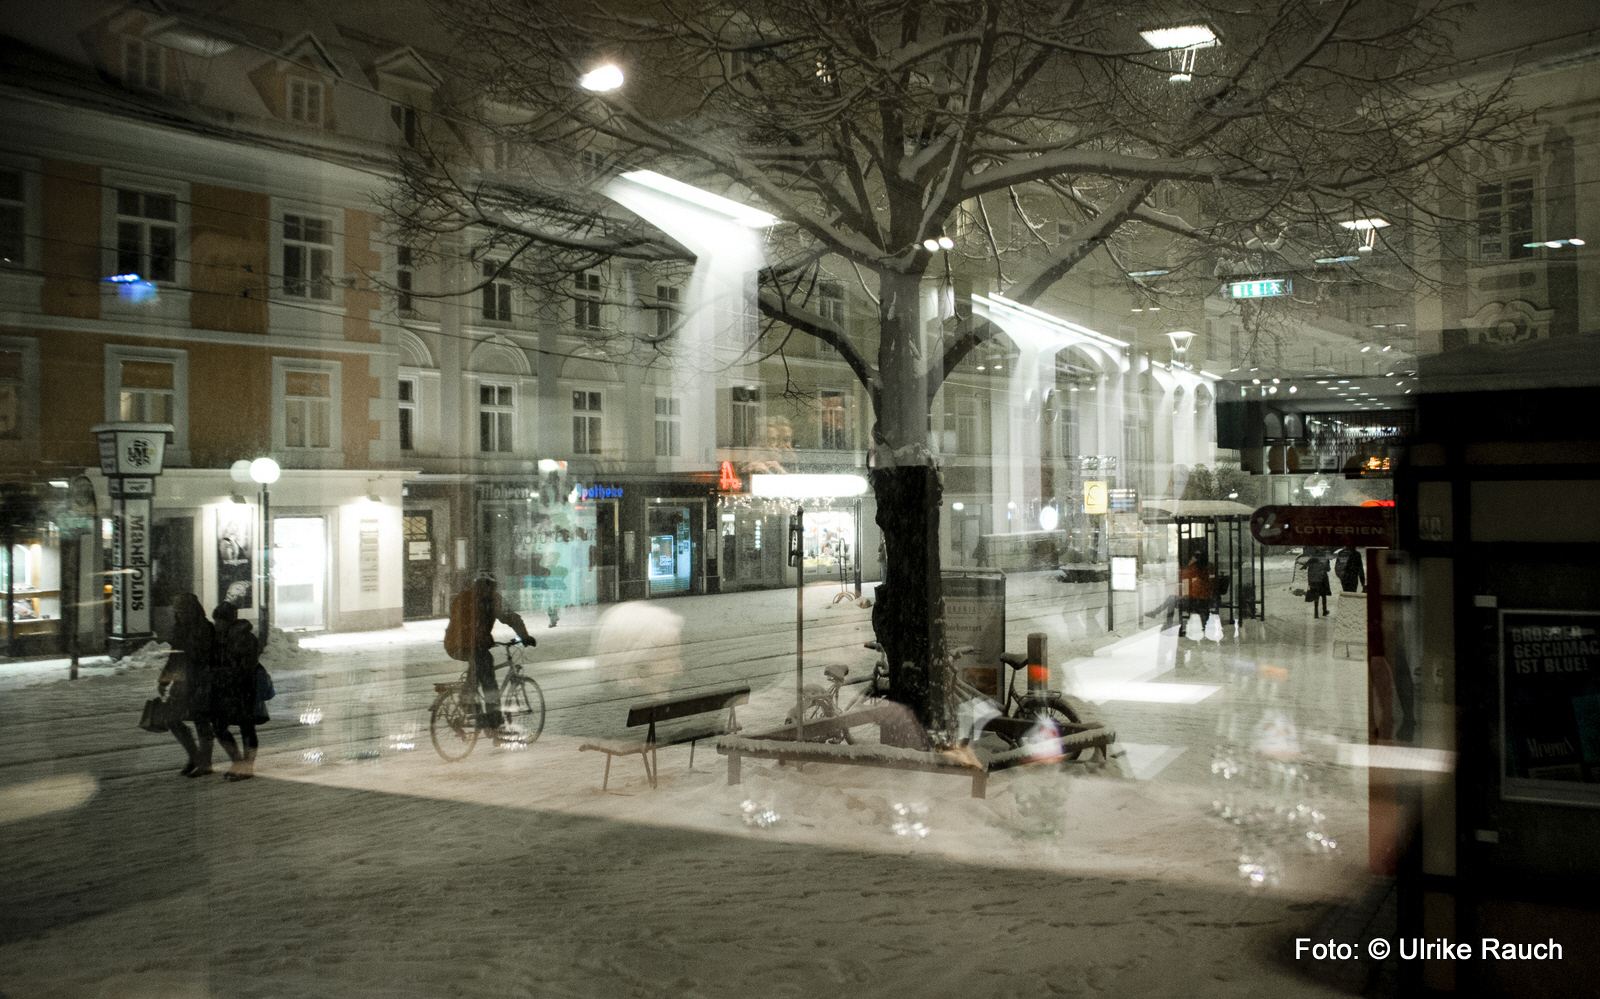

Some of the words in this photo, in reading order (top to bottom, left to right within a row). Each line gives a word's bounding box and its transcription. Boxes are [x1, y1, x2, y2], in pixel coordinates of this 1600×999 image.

[1295, 525, 1384, 536] LOTTERIEN
[1515, 659, 1540, 674] IST
[1543, 657, 1589, 674] BLUE!
